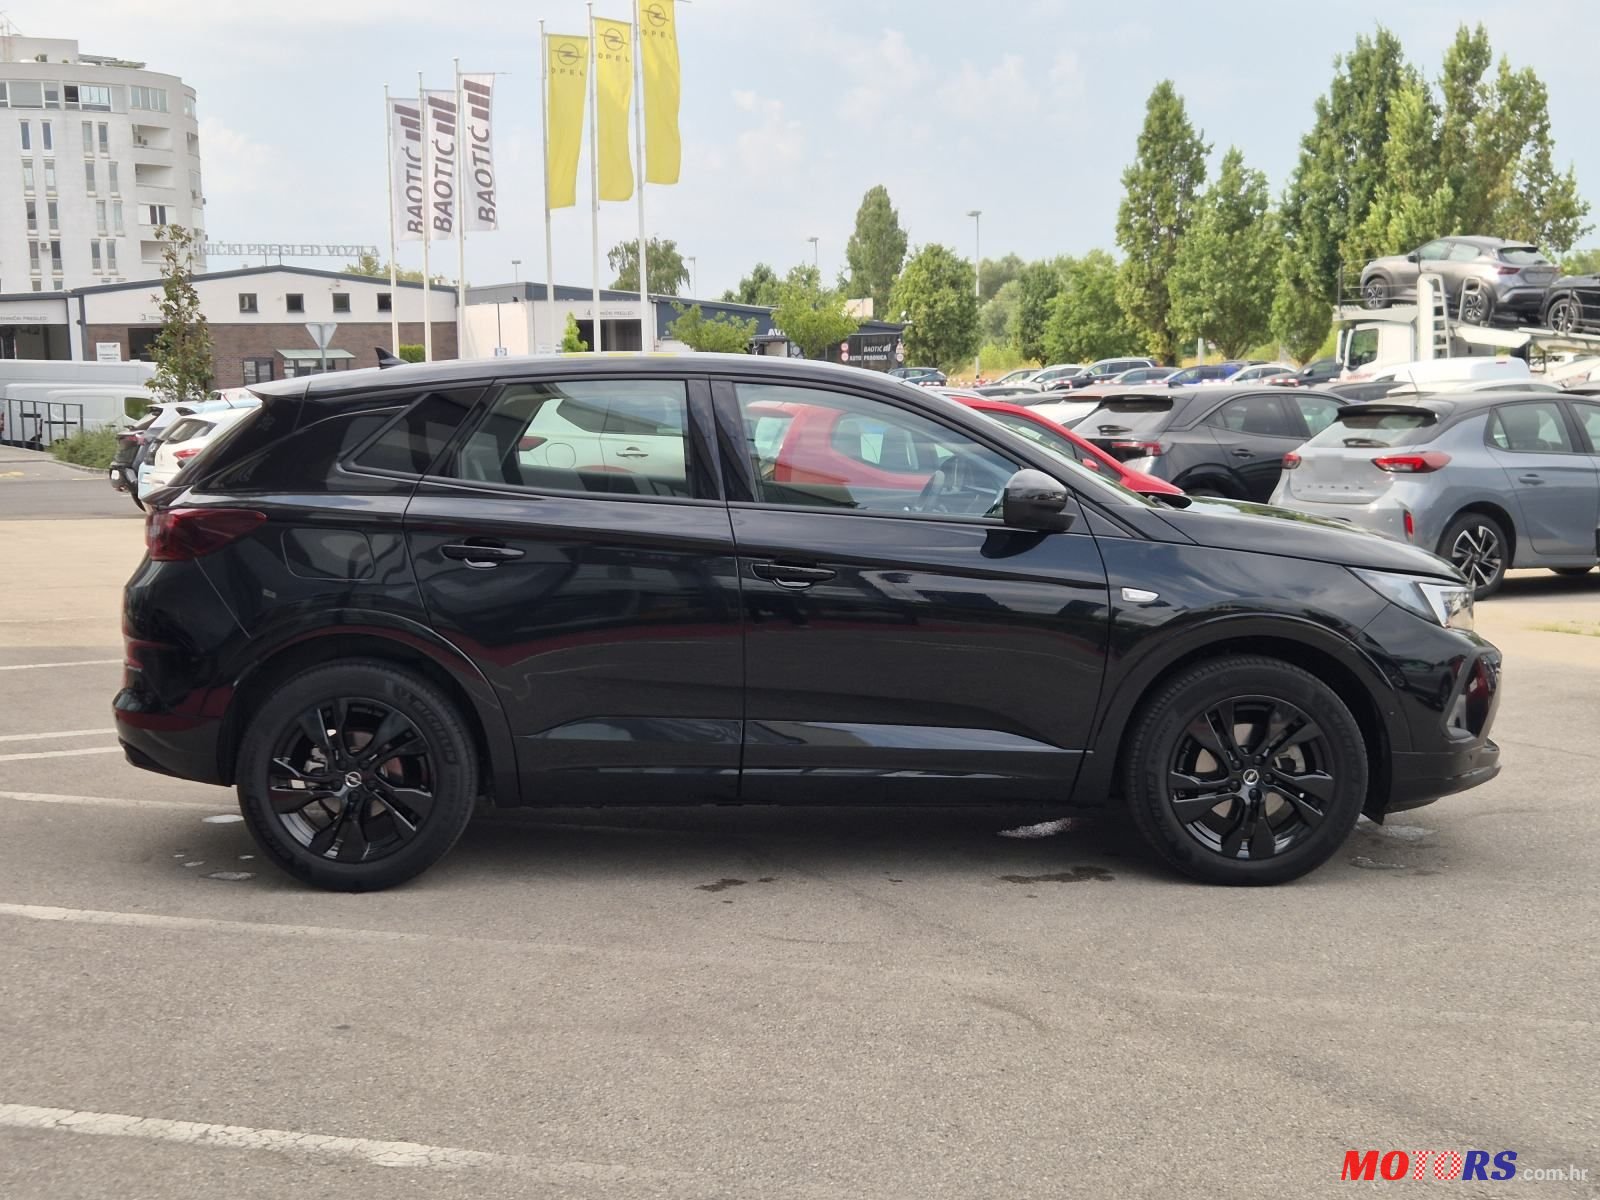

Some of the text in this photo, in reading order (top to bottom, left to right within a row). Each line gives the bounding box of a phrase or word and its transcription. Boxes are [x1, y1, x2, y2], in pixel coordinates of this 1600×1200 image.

[642, 29, 673, 40] OPEL
[597, 52, 630, 63] OPEL
[551, 67, 585, 77] OPEL
[467, 126, 496, 224] BAOTIĆ
[431, 138, 455, 234] BAOTIĆ
[247, 244, 320, 257] PREGLED
[326, 245, 381, 258] VOZILA
